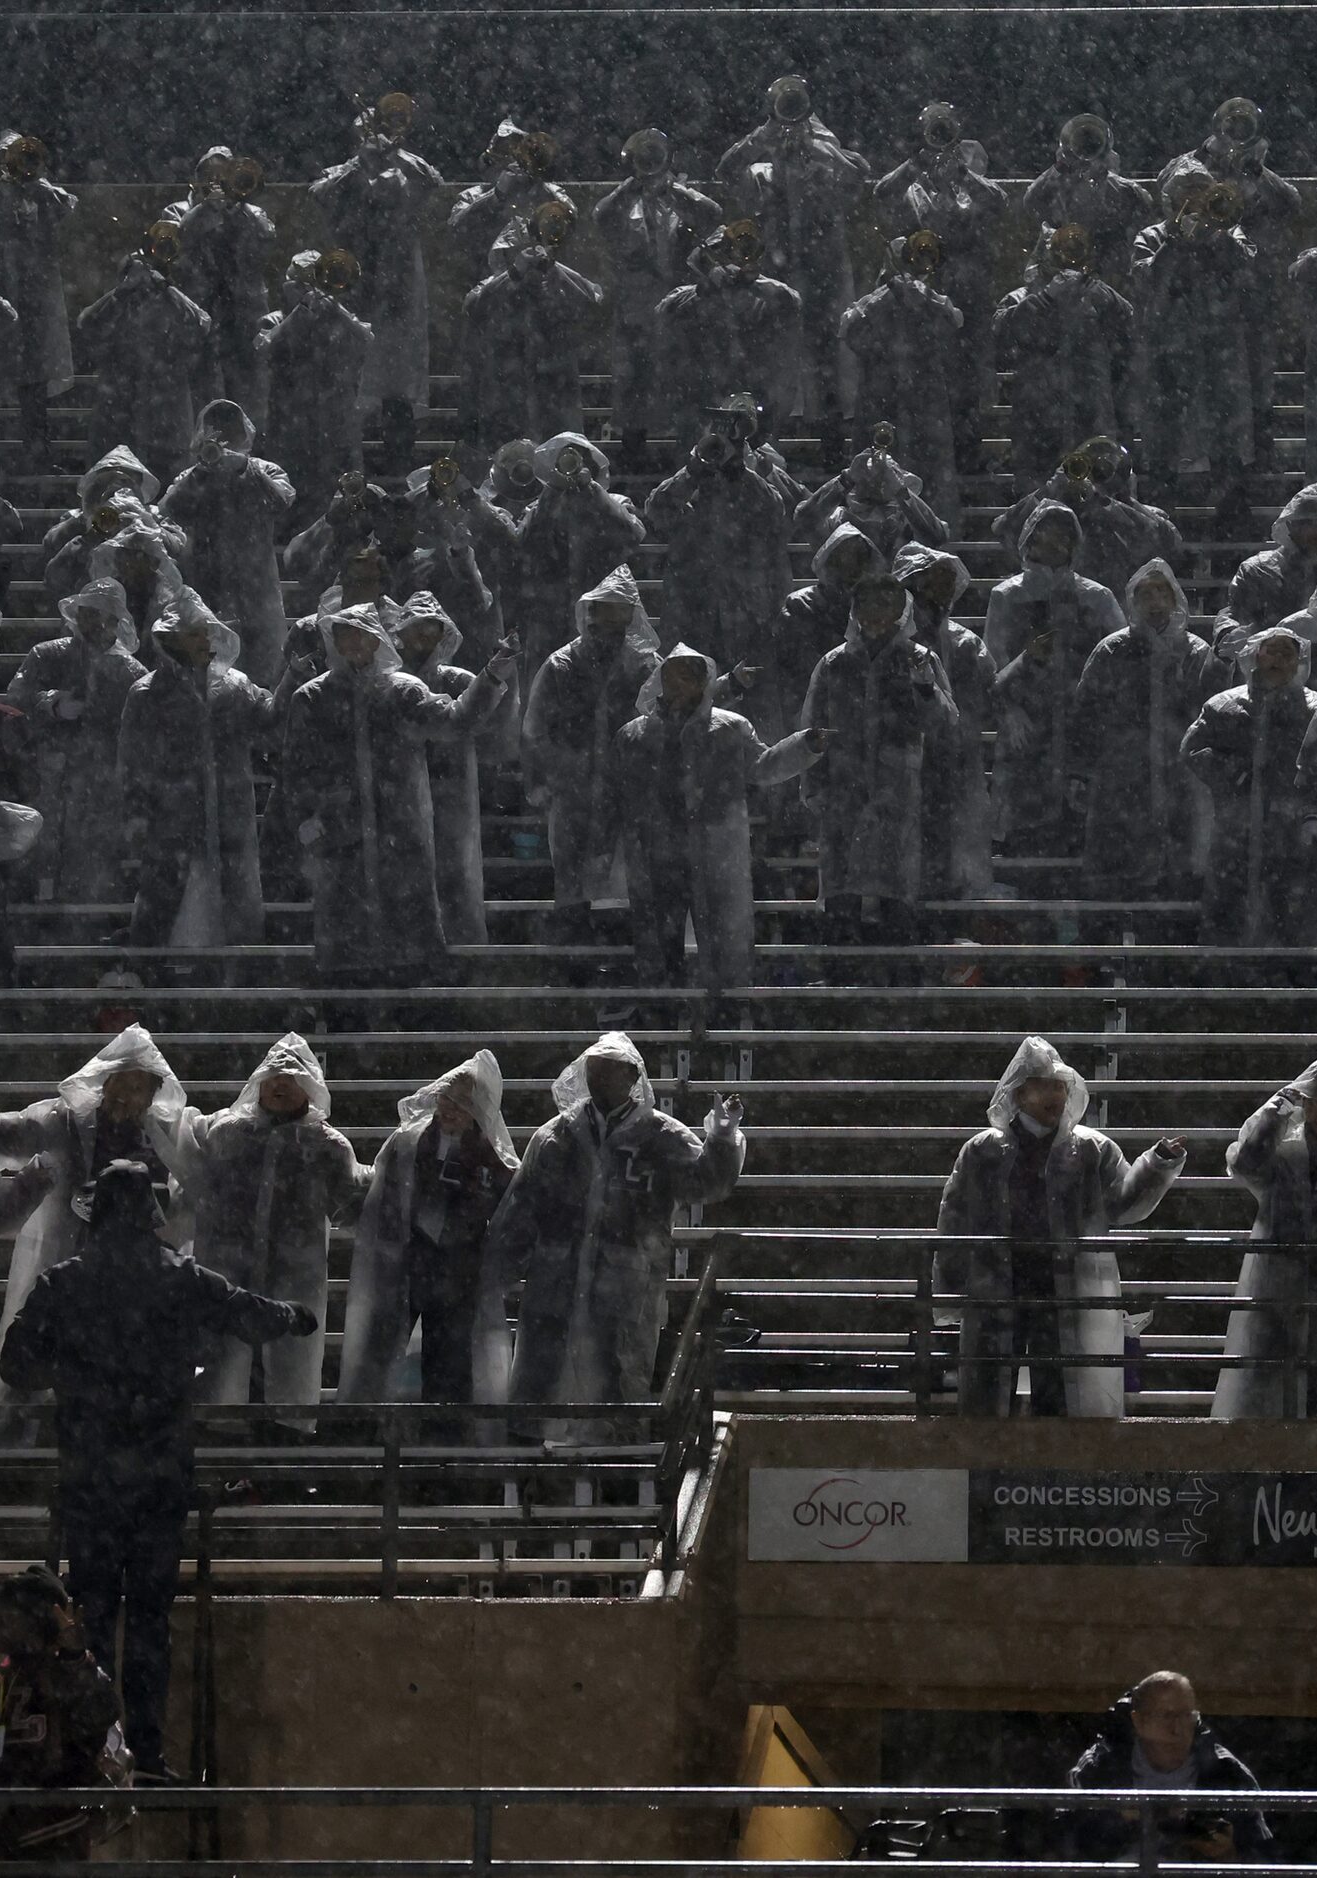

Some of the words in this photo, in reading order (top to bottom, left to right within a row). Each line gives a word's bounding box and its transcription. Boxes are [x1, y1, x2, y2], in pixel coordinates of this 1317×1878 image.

[609, 1145, 655, 1193] L
[994, 1486, 1171, 1506] CONCESSIONS
[793, 1501, 906, 1526] ONCOR
[1005, 1527, 1160, 1547] RESTROOMS
